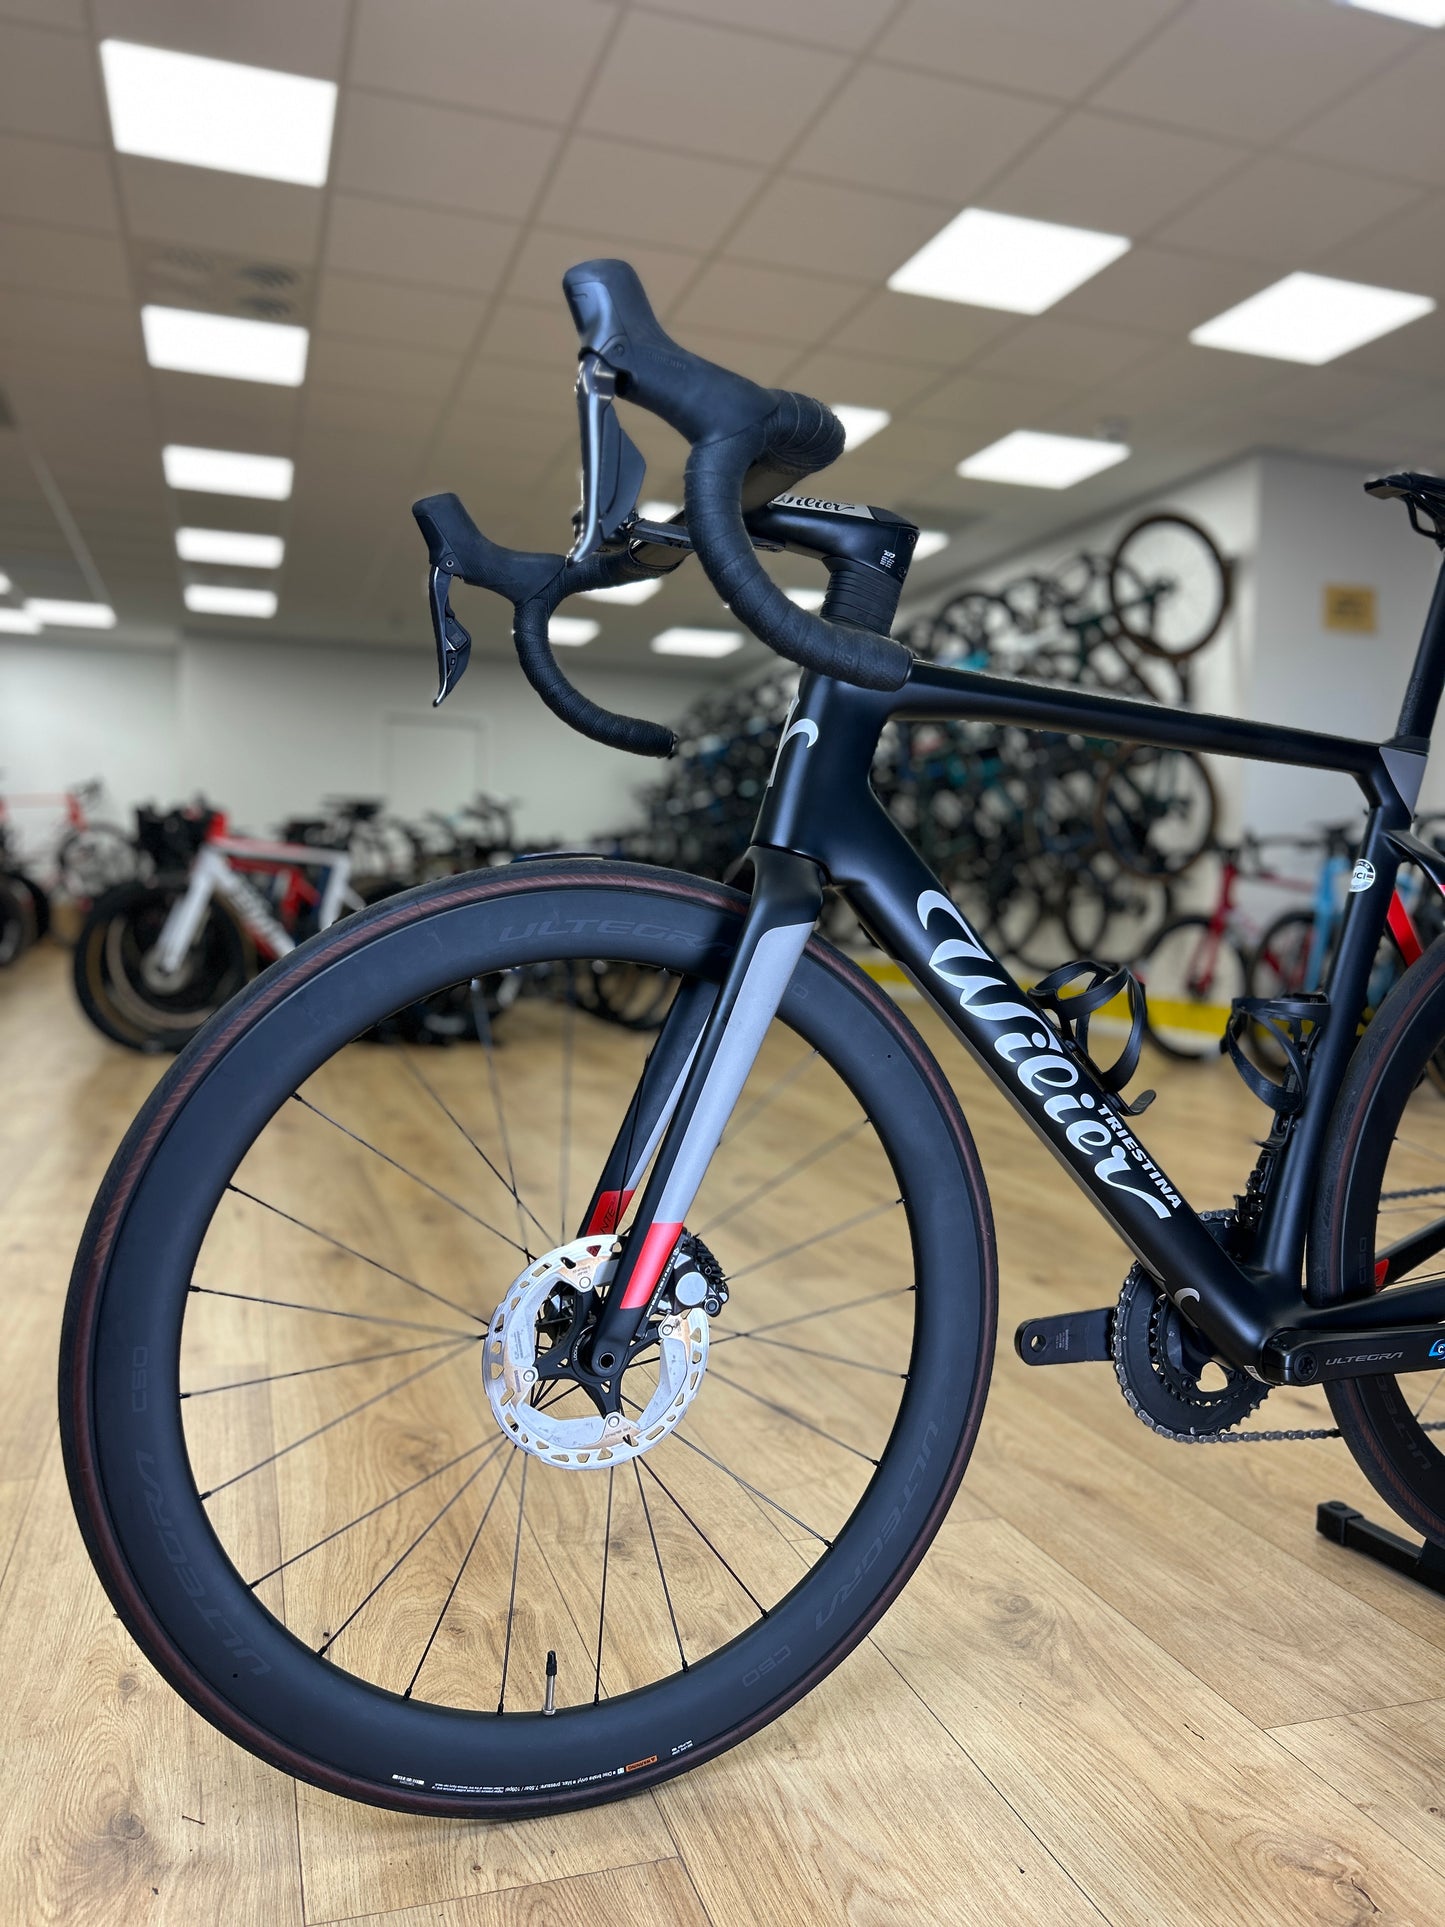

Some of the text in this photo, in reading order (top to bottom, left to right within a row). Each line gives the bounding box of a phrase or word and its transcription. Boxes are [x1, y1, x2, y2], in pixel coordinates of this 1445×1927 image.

[917, 890, 1171, 1219] Wilier
[1098, 1103, 1182, 1209] TRIESTINA
[132, 1346, 148, 1413] C50
[1324, 1351, 1405, 1366] ULTEGRA
[1375, 1375, 1433, 1470] ULTEG
[135, 1451, 272, 1676] ULTEGRA
[815, 1420, 940, 1631] ULTEGRA
[741, 1644, 792, 1688] C50
